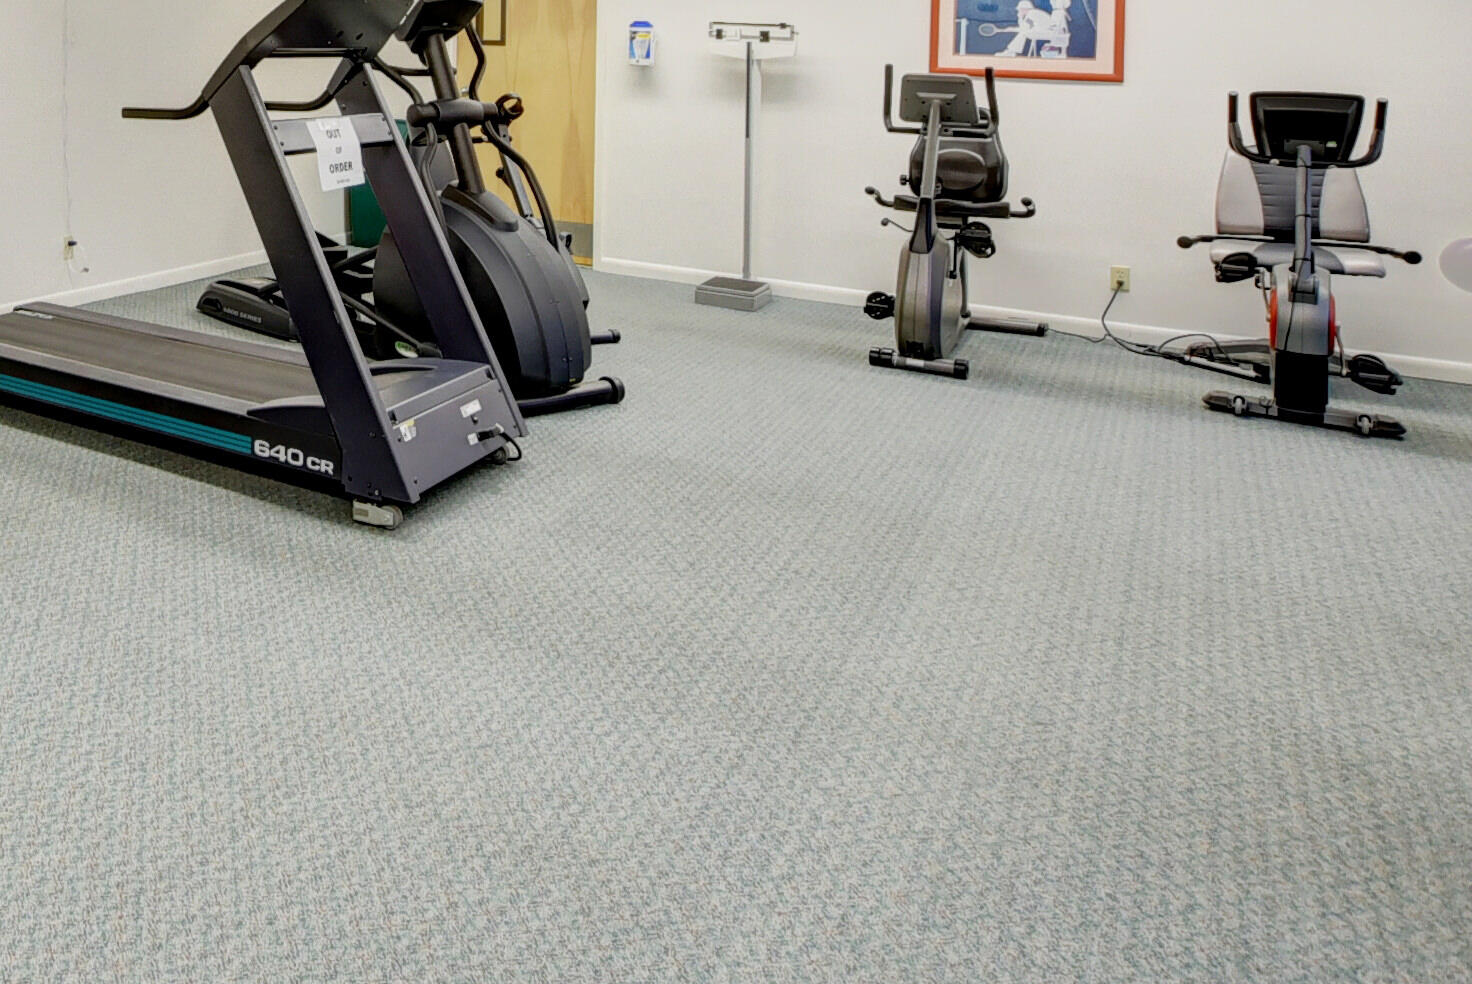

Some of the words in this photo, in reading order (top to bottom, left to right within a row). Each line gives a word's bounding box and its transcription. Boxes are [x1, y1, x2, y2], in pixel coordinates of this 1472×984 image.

[326, 128, 341, 139] OUT
[329, 161, 353, 174] ORDER
[254, 440, 304, 467] 640
[306, 455, 335, 476] CR
